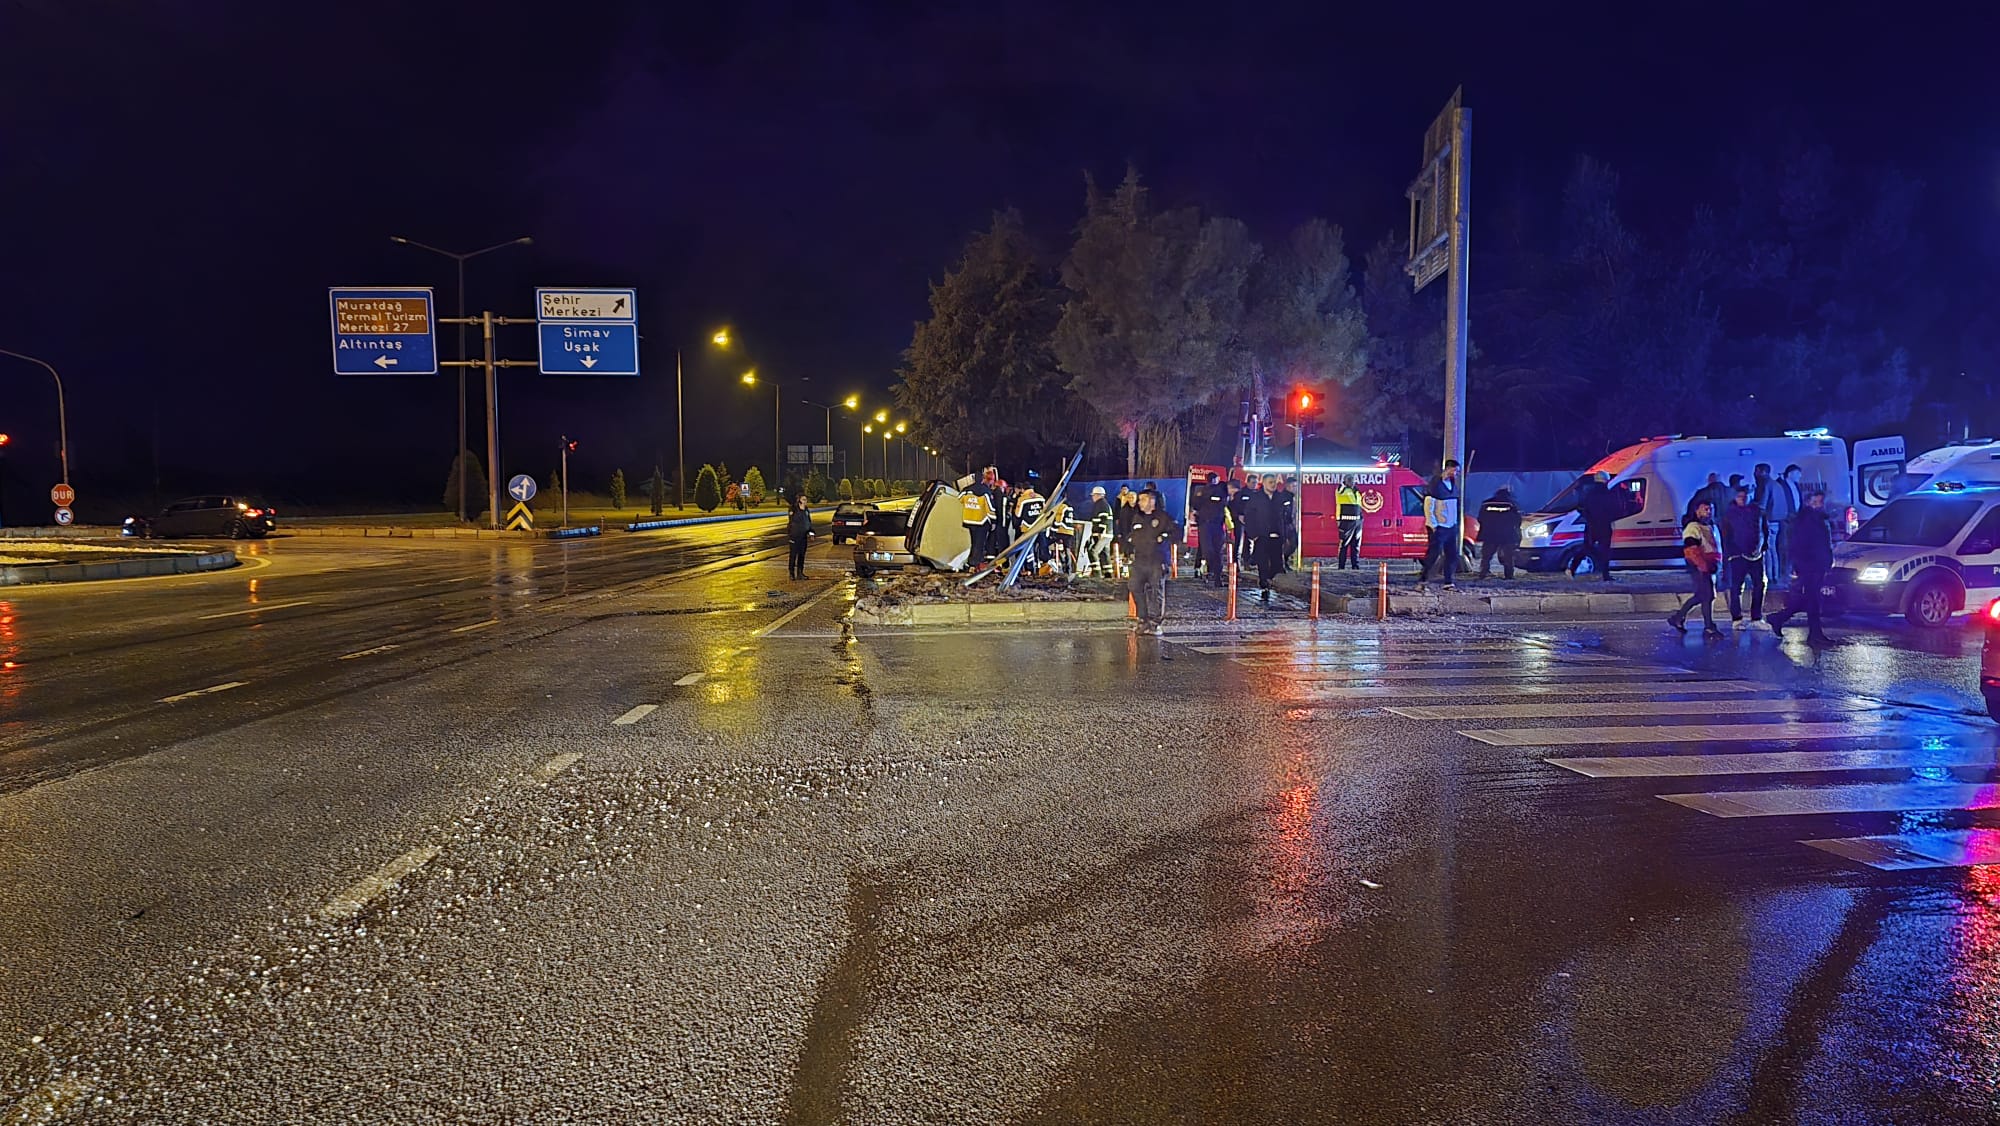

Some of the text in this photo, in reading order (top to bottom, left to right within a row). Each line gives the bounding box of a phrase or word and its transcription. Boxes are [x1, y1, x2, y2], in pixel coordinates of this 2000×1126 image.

[543, 294, 581, 306] Şehir
[338, 301, 402, 312] Muratdağ
[543, 306, 601, 317] Merkezi
[339, 312, 426, 321] Termal Turizm
[340, 322, 409, 332] Merkezi 27
[563, 327, 610, 338] Simav
[339, 339, 402, 351] Altıntaş
[564, 341, 600, 353] Uşak
[1870, 447, 1904, 457] AMBU
[1352, 473, 1386, 485] ARACI
[53, 490, 72, 500] DUR
